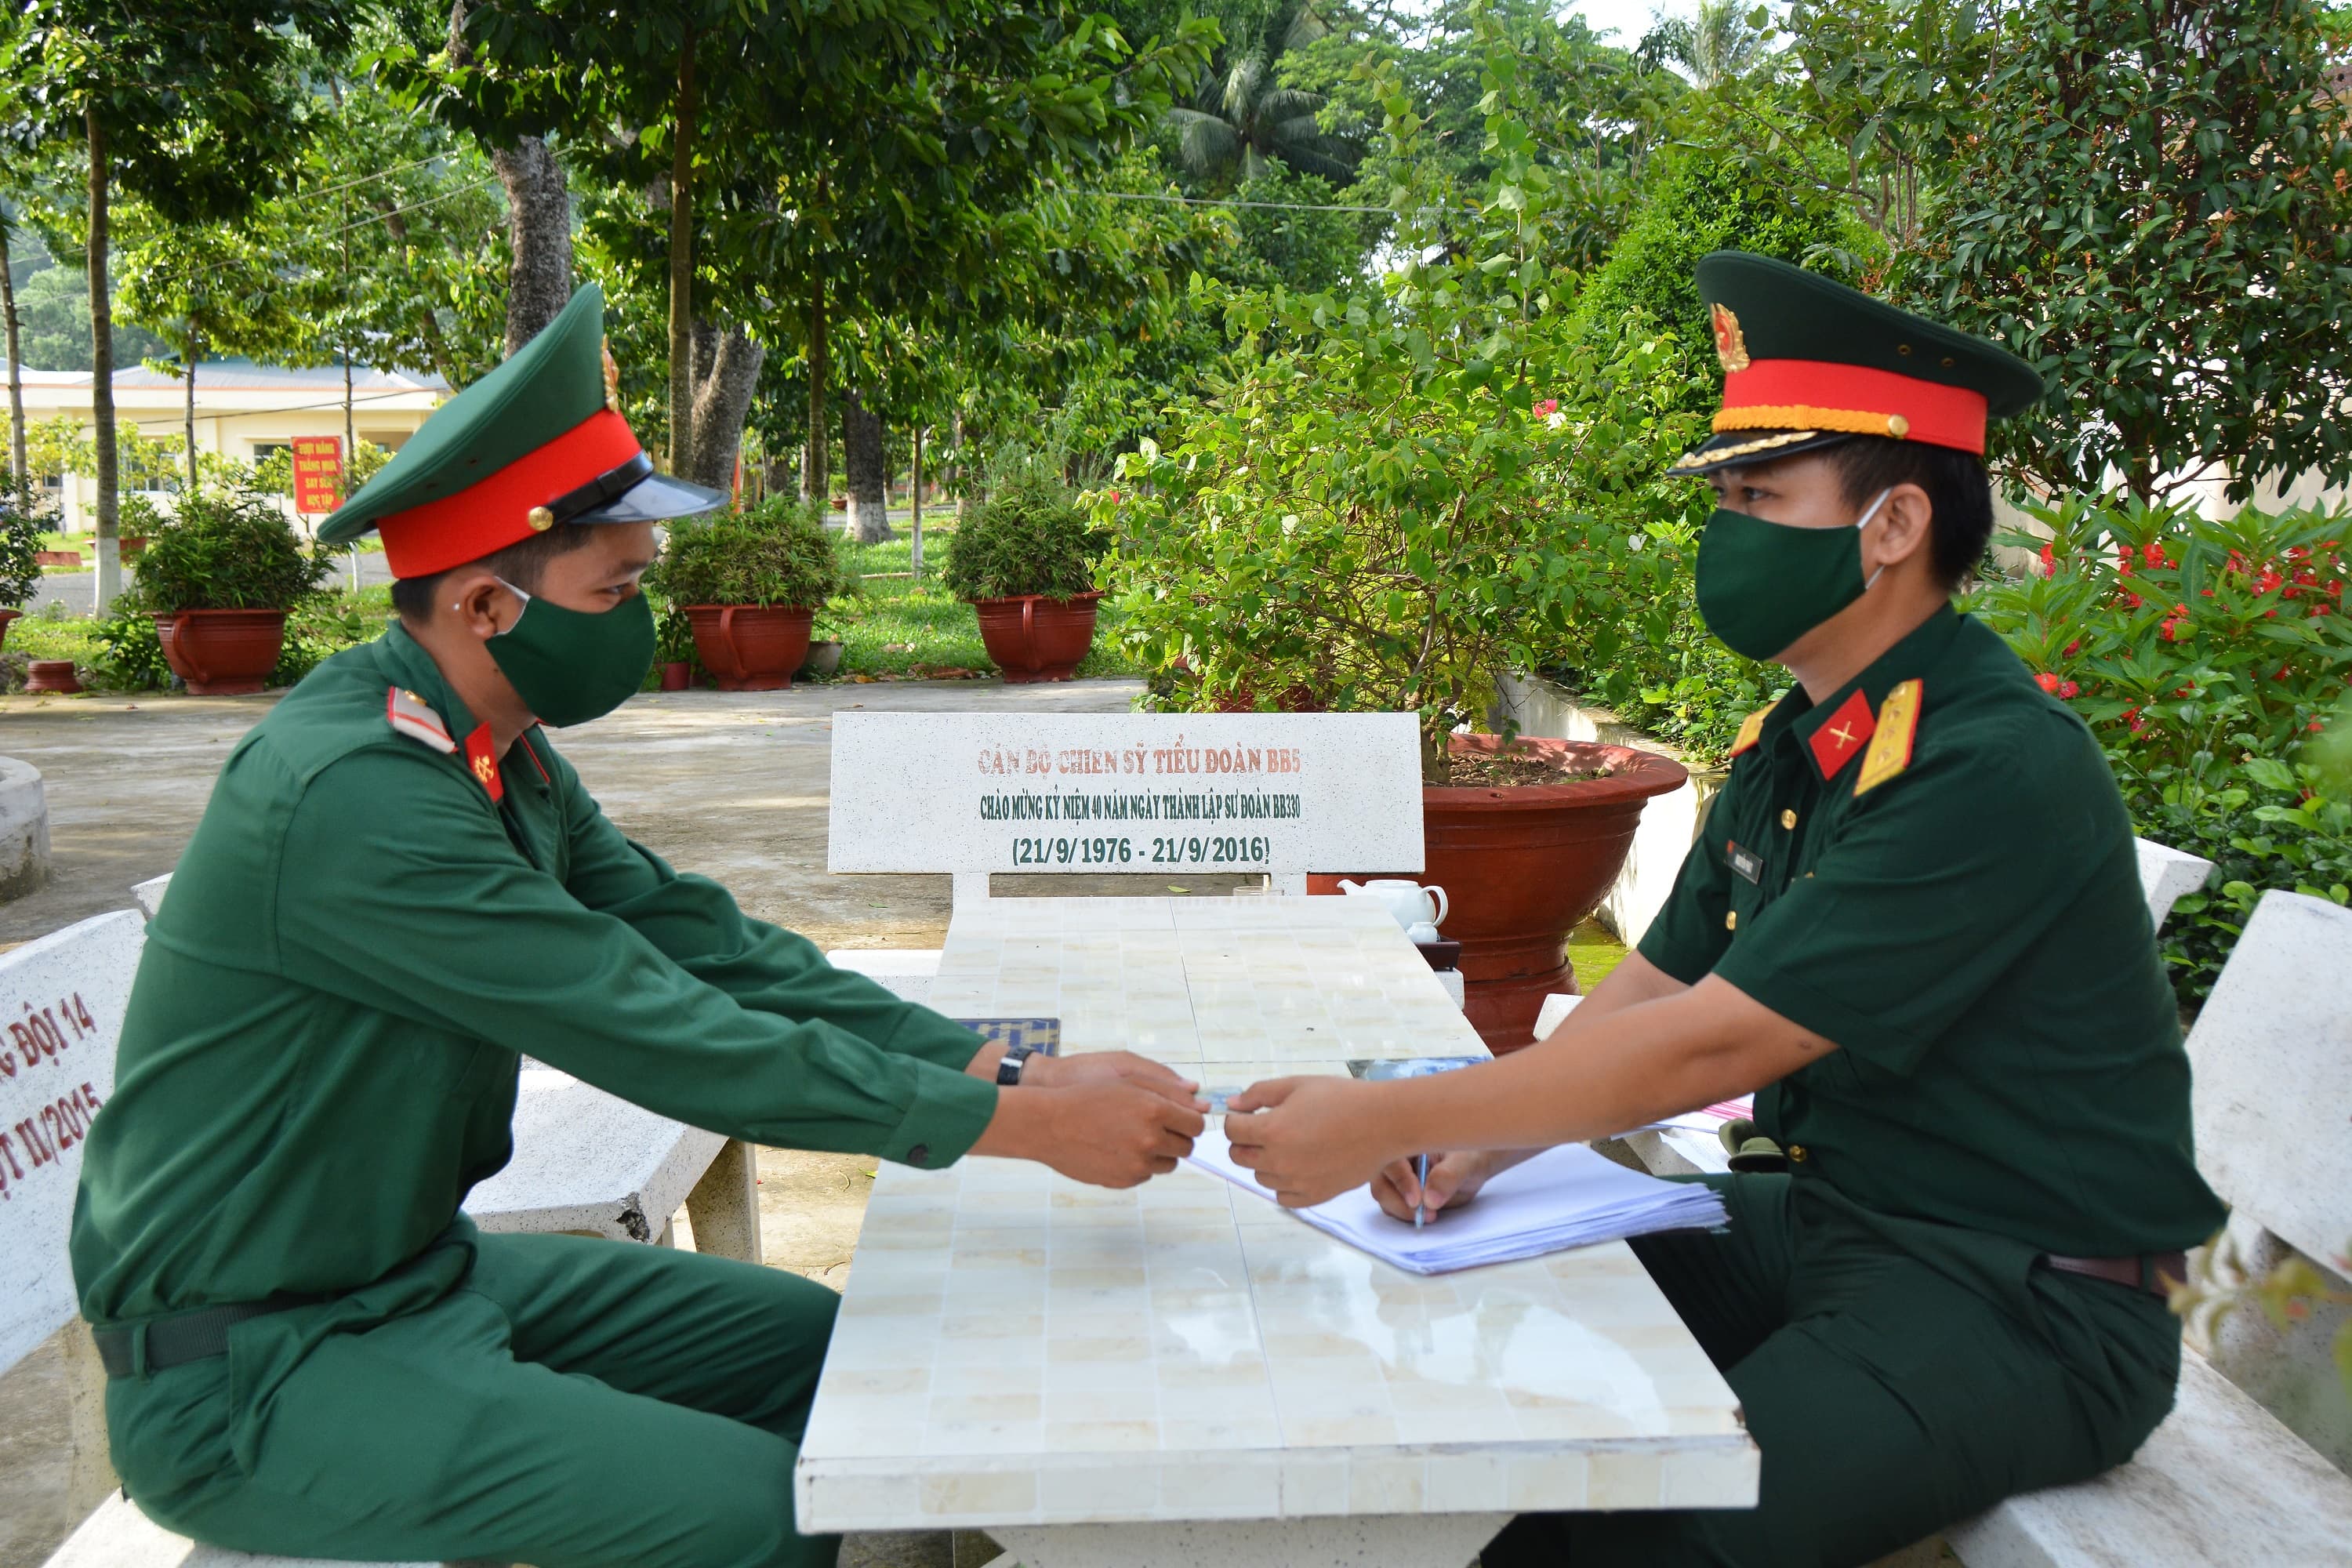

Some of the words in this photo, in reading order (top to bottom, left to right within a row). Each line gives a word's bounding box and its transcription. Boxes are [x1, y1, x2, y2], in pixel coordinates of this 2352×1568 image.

[1123, 742, 1147, 775] SỸ
[1153, 734, 1200, 774] TIỂU
[1205, 742, 1261, 774] ĐOÀN
[1267, 749, 1301, 773] BB5
[980, 788, 1010, 820] CHÀO
[1011, 788, 1043, 820] MỪNG
[1045, 784, 1061, 820] KỶ
[1063, 787, 1090, 826] NIỆM
[1091, 795, 1102, 820] 40
[1104, 789, 1128, 820] NĂM
[1130, 788, 1160, 820] NGÀY
[1163, 787, 1200, 820] THÀNH
[1202, 786, 1222, 825] LẬP
[1225, 789, 1239, 819] SƯ
[1240, 786, 1270, 819] ĐOÀN
[1272, 794, 1301, 819] BB330
[1012, 837, 1132, 866] (21/9/1976
[9, 1000, 69, 1067] ĐỘI
[60, 991, 98, 1040] 14
